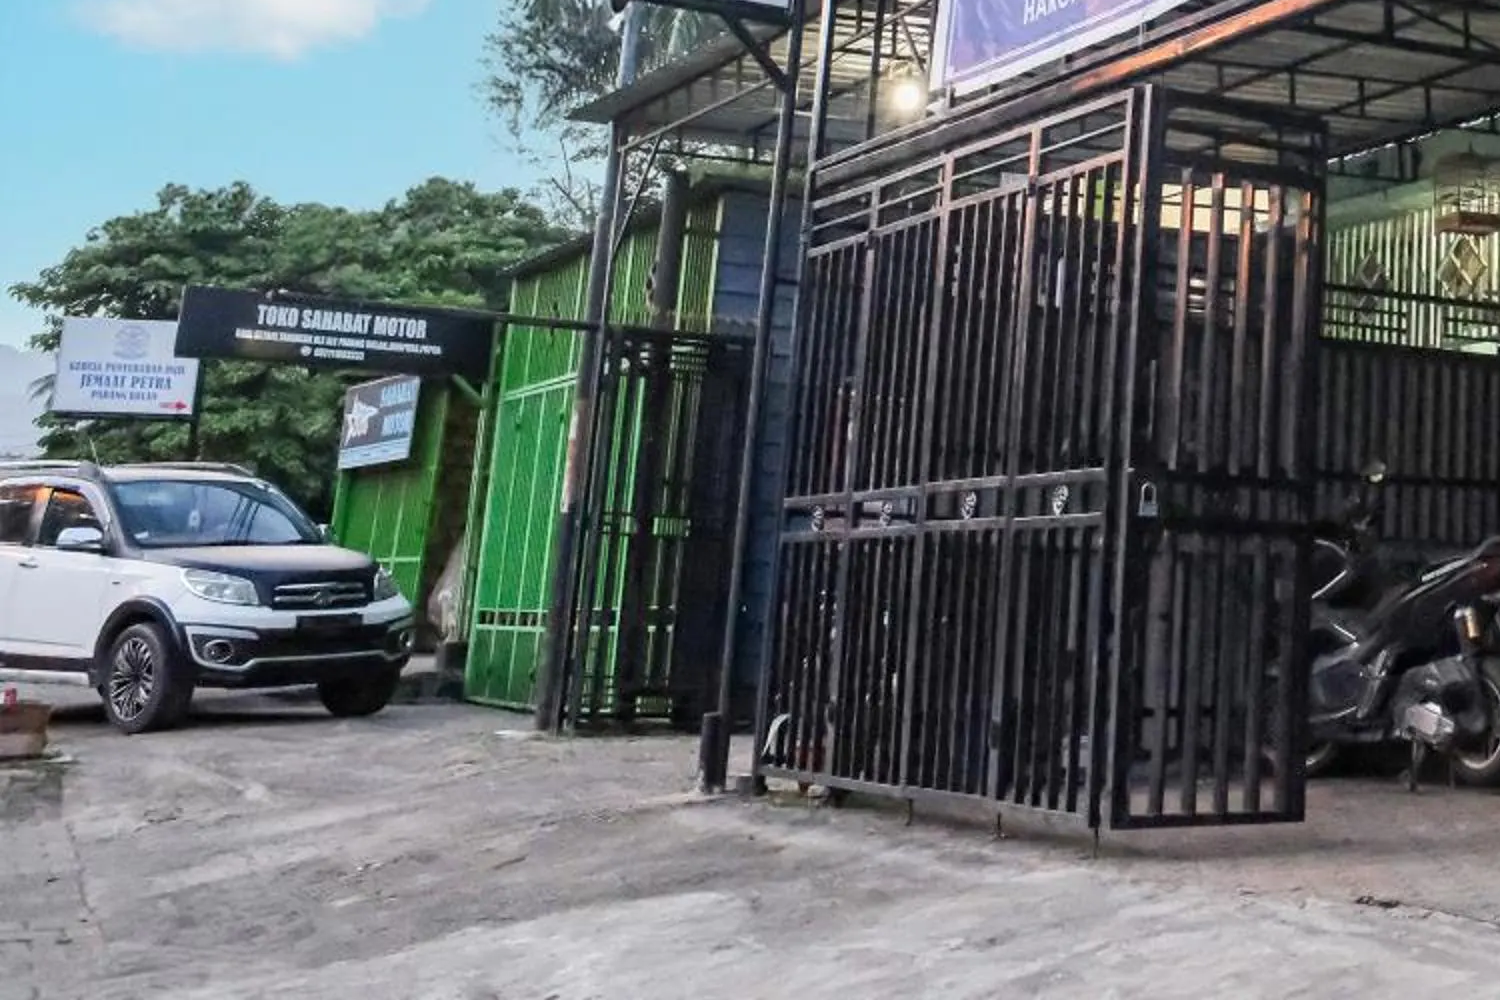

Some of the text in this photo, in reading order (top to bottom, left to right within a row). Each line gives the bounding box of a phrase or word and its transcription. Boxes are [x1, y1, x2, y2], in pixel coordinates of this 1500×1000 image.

[257, 304, 427, 339] TOKO SAHABAT MOTOR
